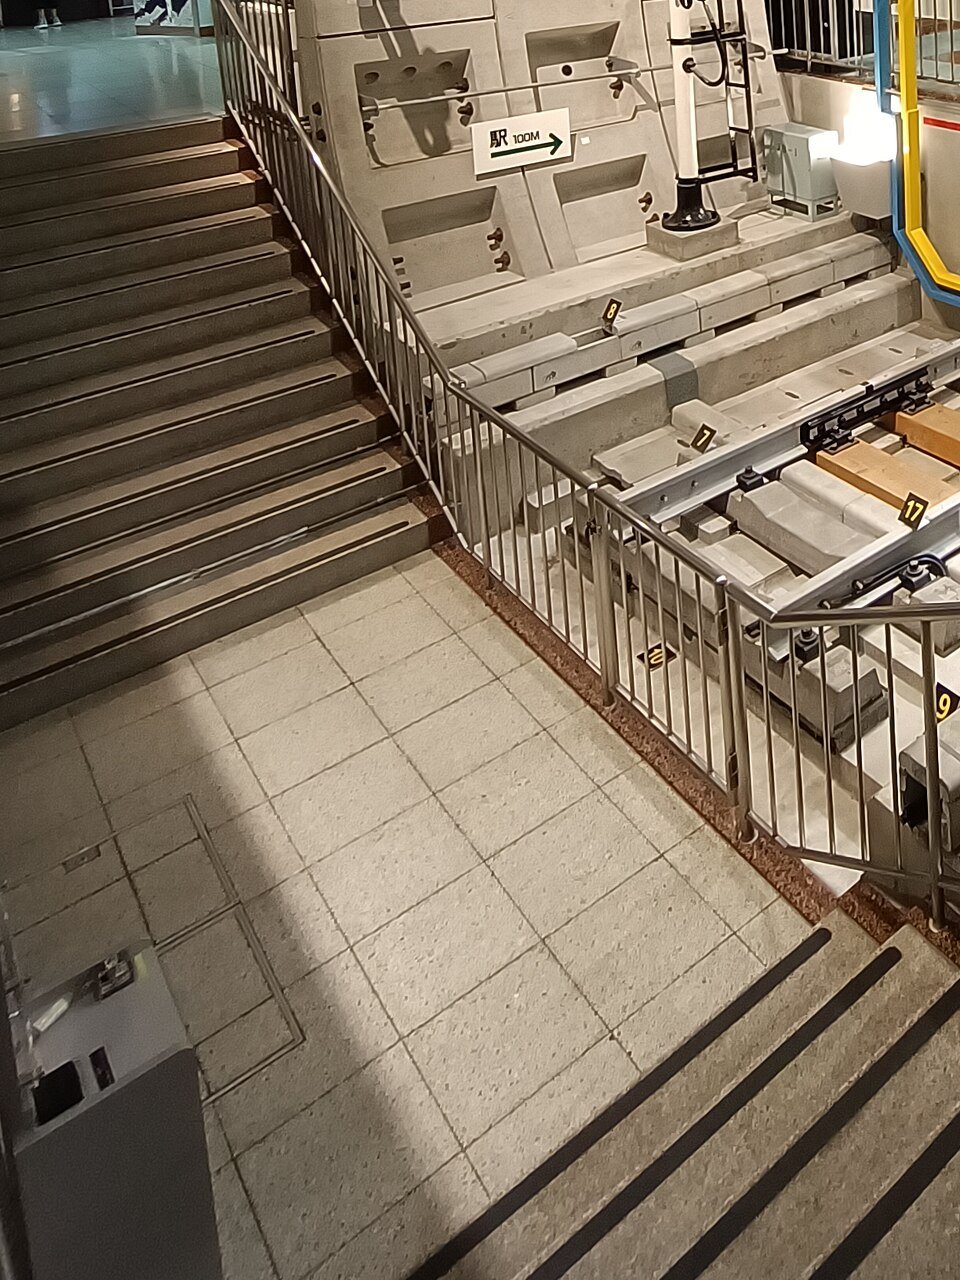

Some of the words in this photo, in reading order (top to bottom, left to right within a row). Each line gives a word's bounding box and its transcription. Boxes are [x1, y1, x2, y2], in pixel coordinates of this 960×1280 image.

[489, 128, 508, 148] 駅
[512, 130, 540, 144] 100M
[607, 303, 617, 319] 8
[697, 429, 710, 446] 7
[905, 500, 924, 521] 17
[936, 693, 951, 719] 9
